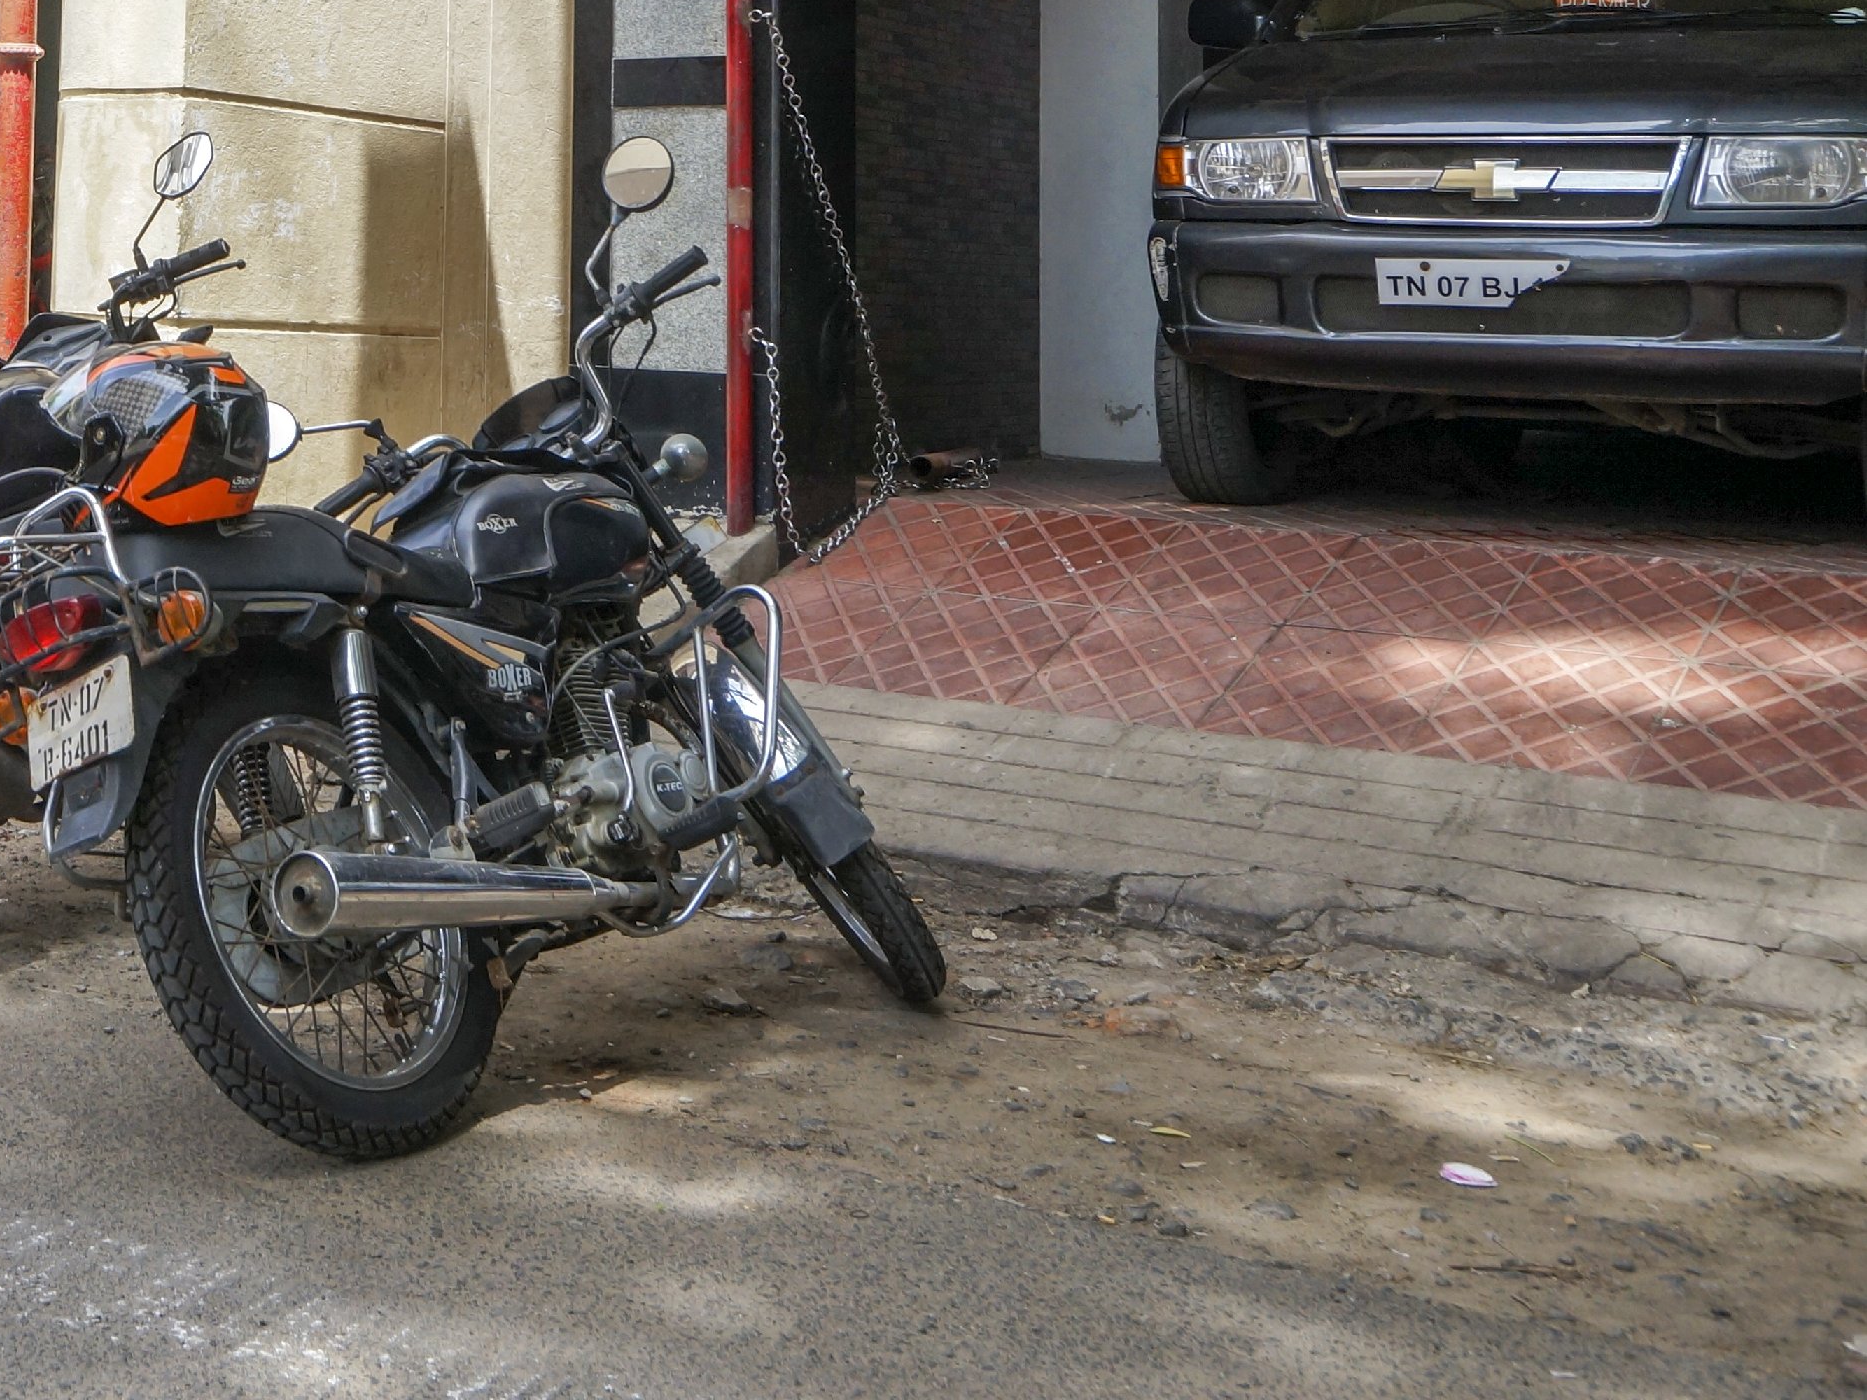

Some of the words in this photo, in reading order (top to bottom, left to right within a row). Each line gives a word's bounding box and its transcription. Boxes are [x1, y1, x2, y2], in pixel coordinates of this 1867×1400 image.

[1386, 275, 1427, 297] TN
[1437, 276, 1470, 297] 07
[1481, 277, 1520, 299] BJ
[477, 513, 519, 534] BOXER
[487, 663, 533, 693] BOXER
